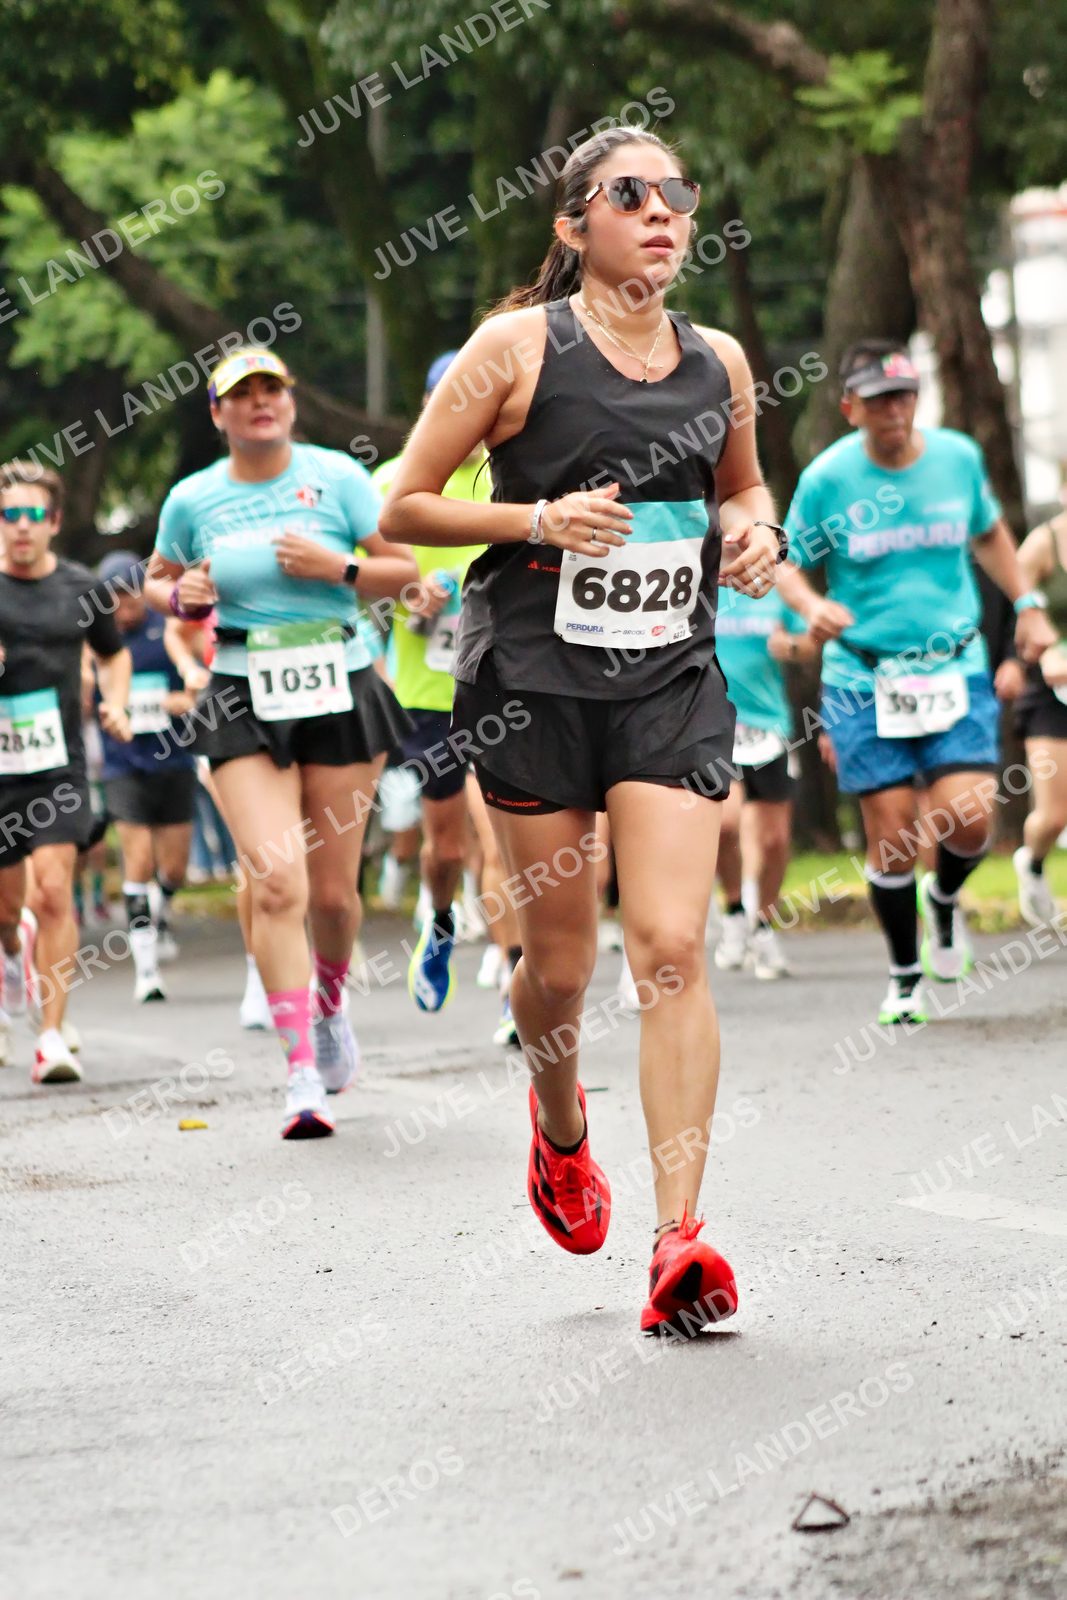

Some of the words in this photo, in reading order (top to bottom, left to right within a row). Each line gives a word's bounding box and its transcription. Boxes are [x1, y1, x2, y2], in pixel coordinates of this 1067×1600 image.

[572, 566, 693, 612] 6828
[566, 622, 604, 633] PERDURA
[259, 662, 337, 695] 1031
